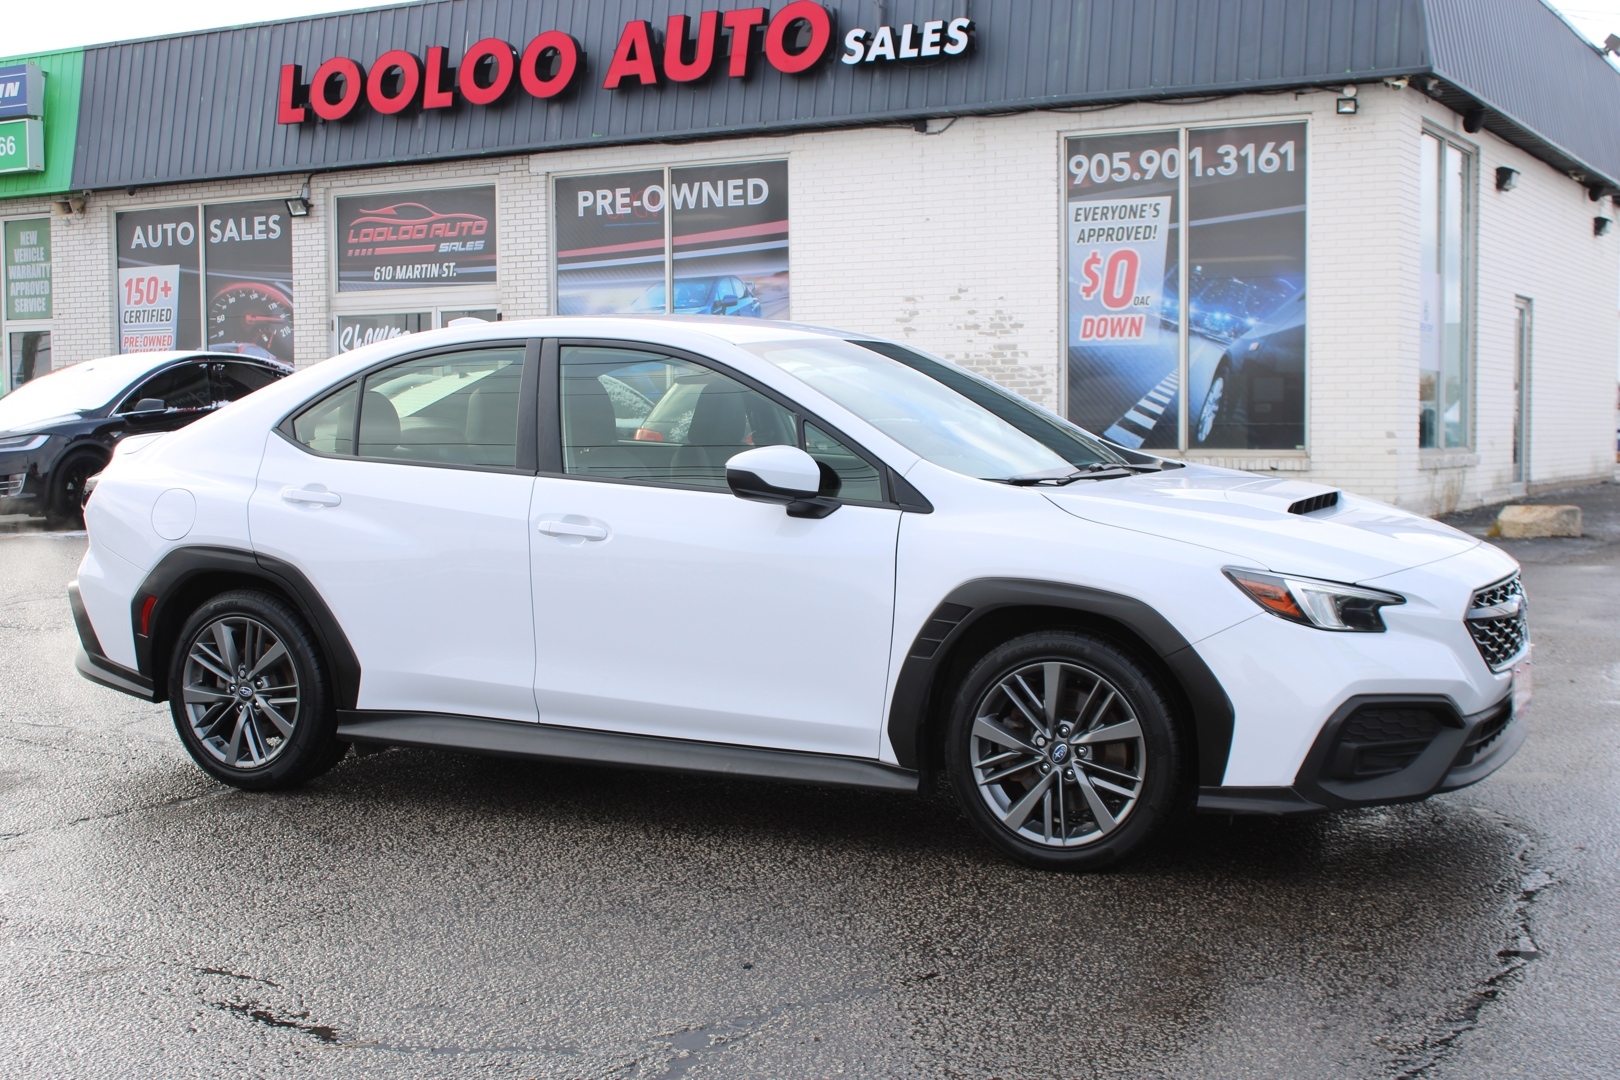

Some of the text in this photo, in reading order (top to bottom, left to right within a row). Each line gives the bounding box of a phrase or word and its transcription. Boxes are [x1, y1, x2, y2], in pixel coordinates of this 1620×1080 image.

[278, 0, 970, 124] LOOLOO AUTO SALES
[1069, 140, 1295, 184] 905.901.3161
[577, 177, 769, 217] PRE-OWNED
[1074, 202, 1161, 222] EVERYONE'S
[20, 230, 37, 246] NEW
[131, 214, 281, 249] AUTO SALES
[348, 220, 488, 243] LOOLOO AUTO
[1076, 224, 1158, 244] APPROVED!
[14, 247, 45, 263] VEHICLE
[438, 240, 485, 253] SALES
[8, 264, 51, 280] WARRANTY
[373, 262, 457, 281] 610 MARTIN ST.
[1081, 249, 1139, 310] $0
[10, 280, 49, 297] APPROVED
[124, 276, 172, 306] 150+
[14, 297, 46, 313] SERVICE
[1133, 295, 1151, 307] OAC
[123, 308, 172, 325] CERTIFIED
[1081, 315, 1143, 339] DOWN
[123, 334, 173, 349] PRE-OWNED
